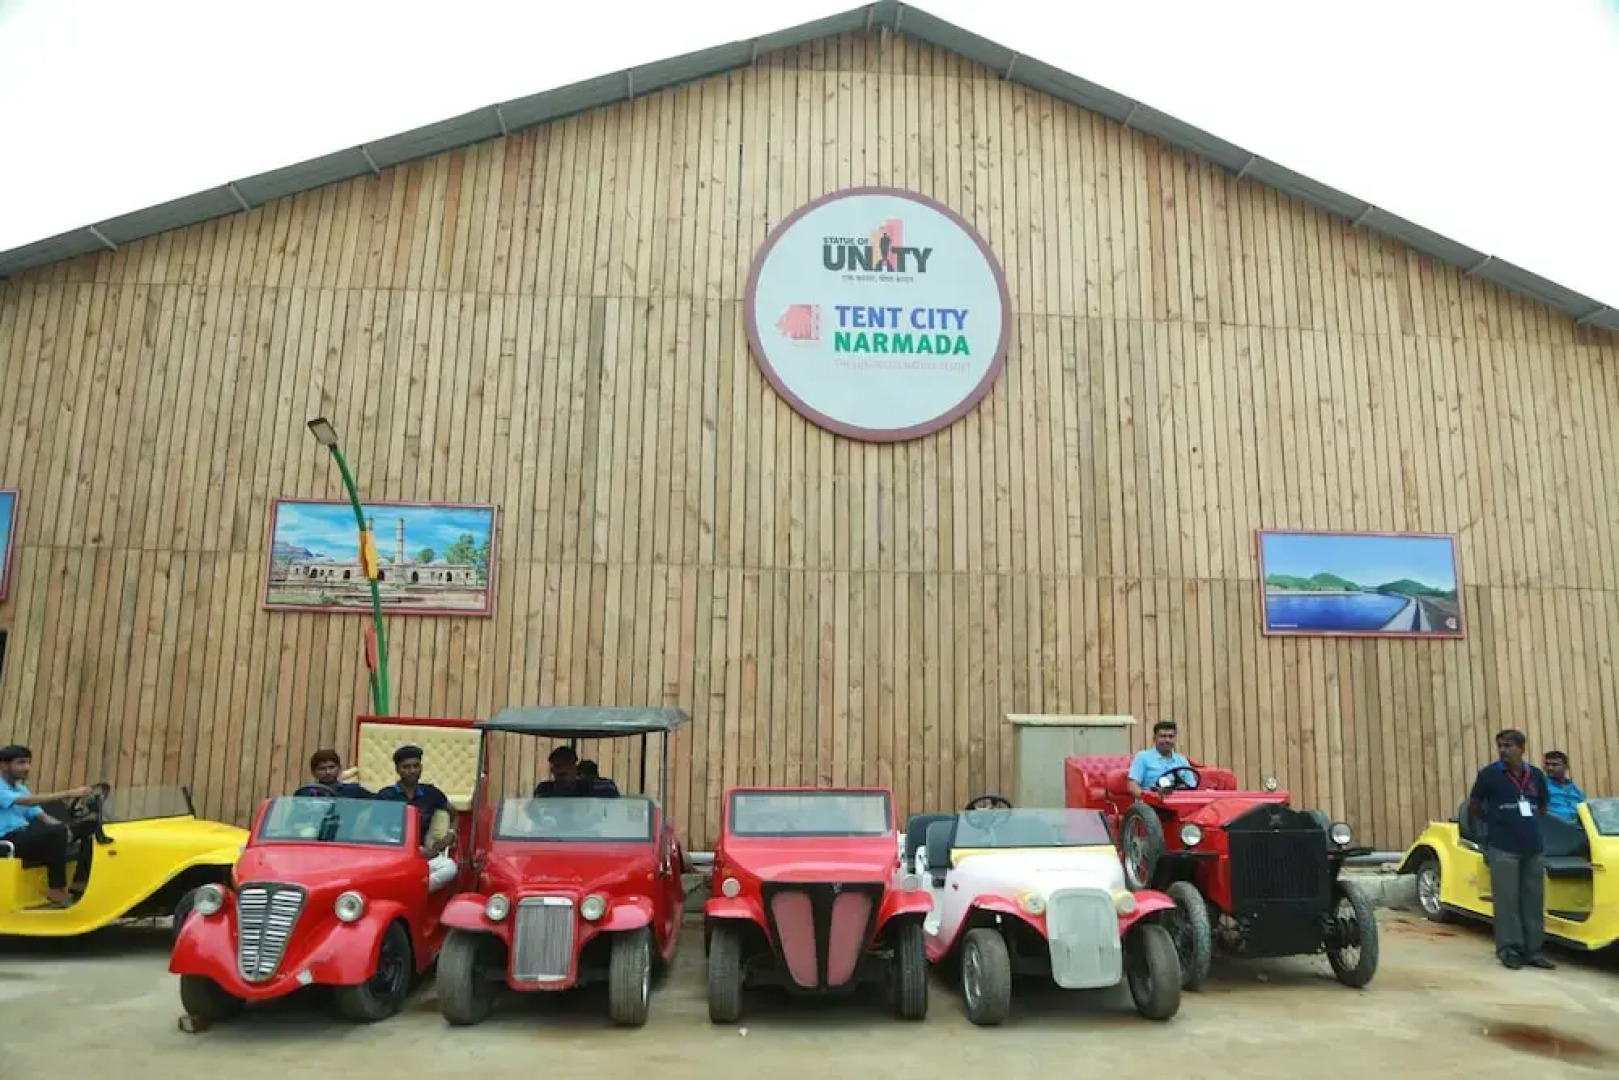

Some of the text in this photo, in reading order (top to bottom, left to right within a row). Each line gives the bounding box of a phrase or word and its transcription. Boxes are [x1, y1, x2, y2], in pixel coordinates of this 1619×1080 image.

[823, 237, 869, 245] STATUE OF
[835, 305, 969, 330] TENT CITY
[834, 331, 971, 355] NARMADA
